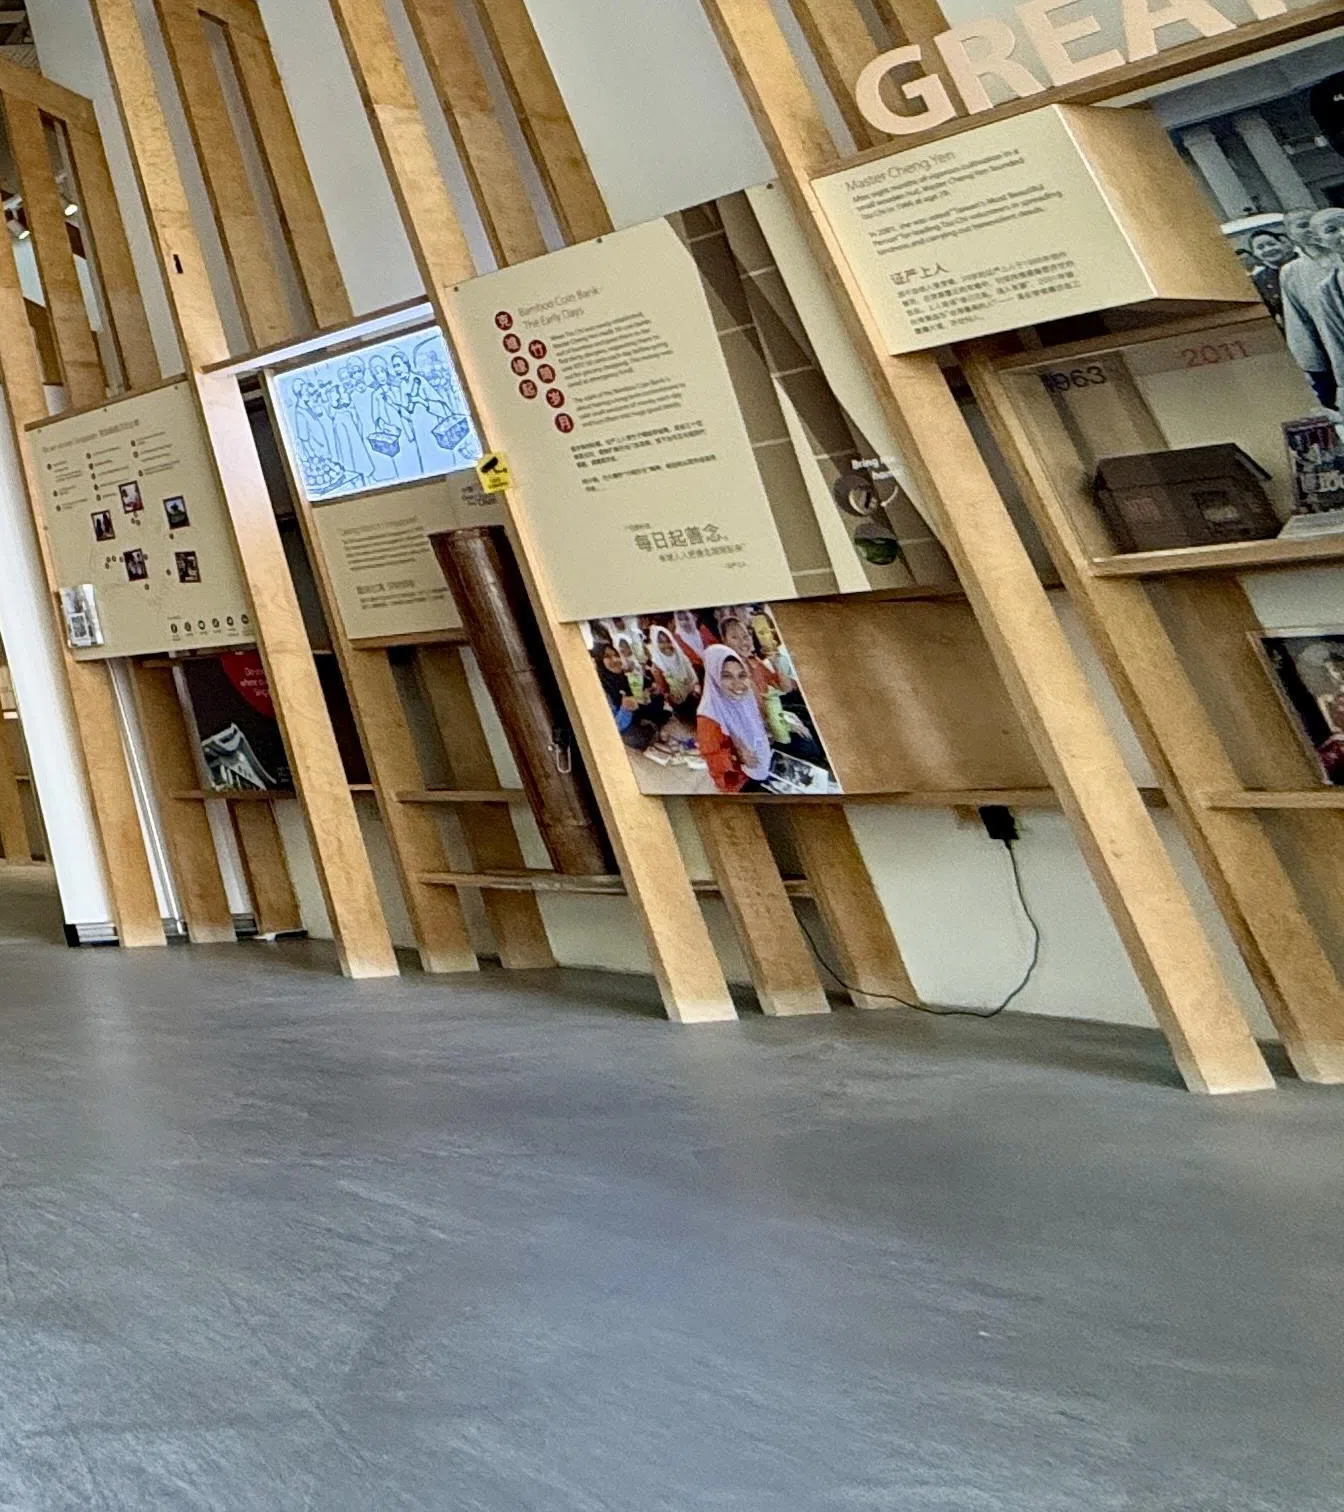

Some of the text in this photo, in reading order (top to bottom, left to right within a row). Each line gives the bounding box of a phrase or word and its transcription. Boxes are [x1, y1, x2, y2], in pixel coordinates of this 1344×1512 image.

[844, 151, 956, 192] Master Cheng Yen
[1180, 341, 1250, 368] 2011
